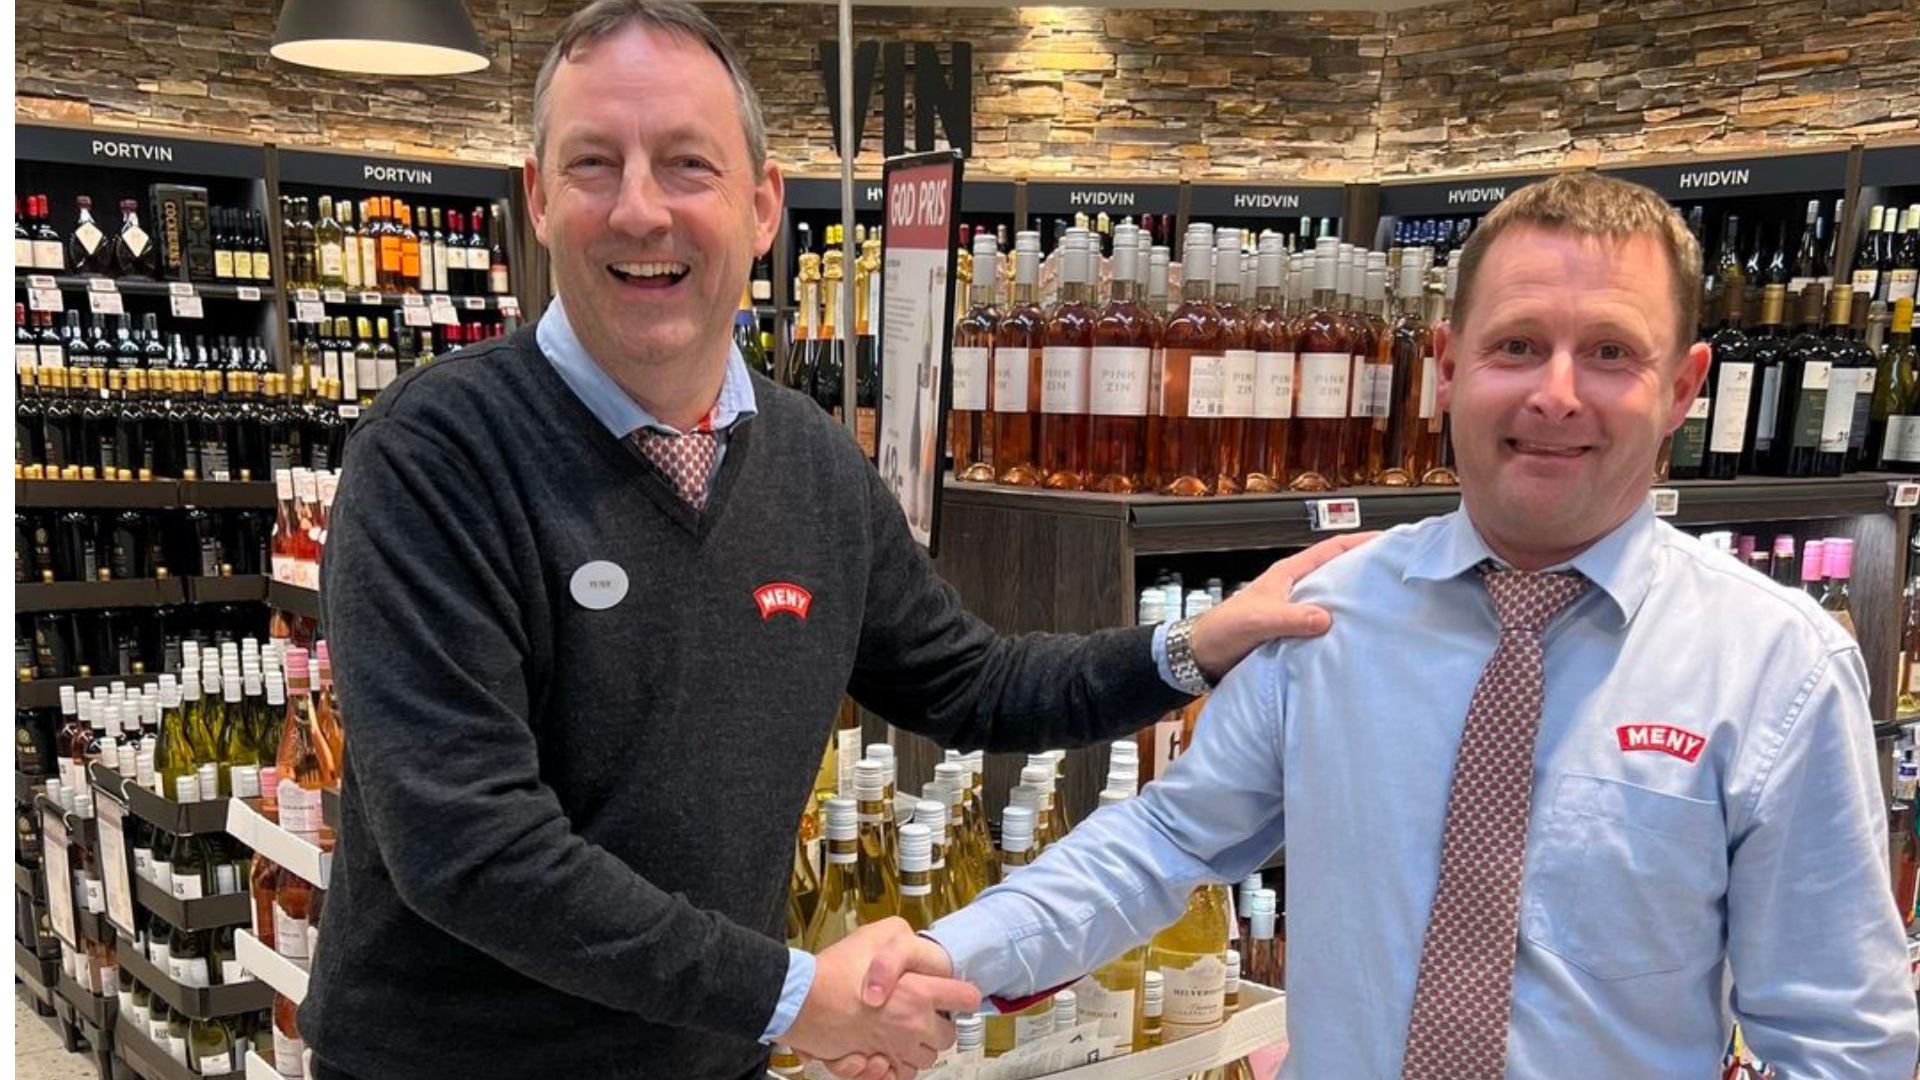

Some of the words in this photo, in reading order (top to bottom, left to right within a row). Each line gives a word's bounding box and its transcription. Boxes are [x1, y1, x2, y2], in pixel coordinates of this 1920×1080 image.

[819, 40, 972, 158] VIN
[92, 140, 173, 161] PORTVIN
[364, 165, 432, 184] PORTVIN
[1679, 169, 1749, 188] HVIDVIN
[891, 182, 916, 227] GOD
[918, 178, 947, 226] PRIS
[1070, 192, 1135, 206] HVIDVIN
[1234, 194, 1300, 208] HVIDVIN
[1449, 187, 1505, 204] HVIDVIN
[1101, 369, 1136, 380] PINK
[1106, 382, 1130, 392] ZIN
[762, 589, 807, 610] MENY
[1627, 727, 1702, 755] MENY
